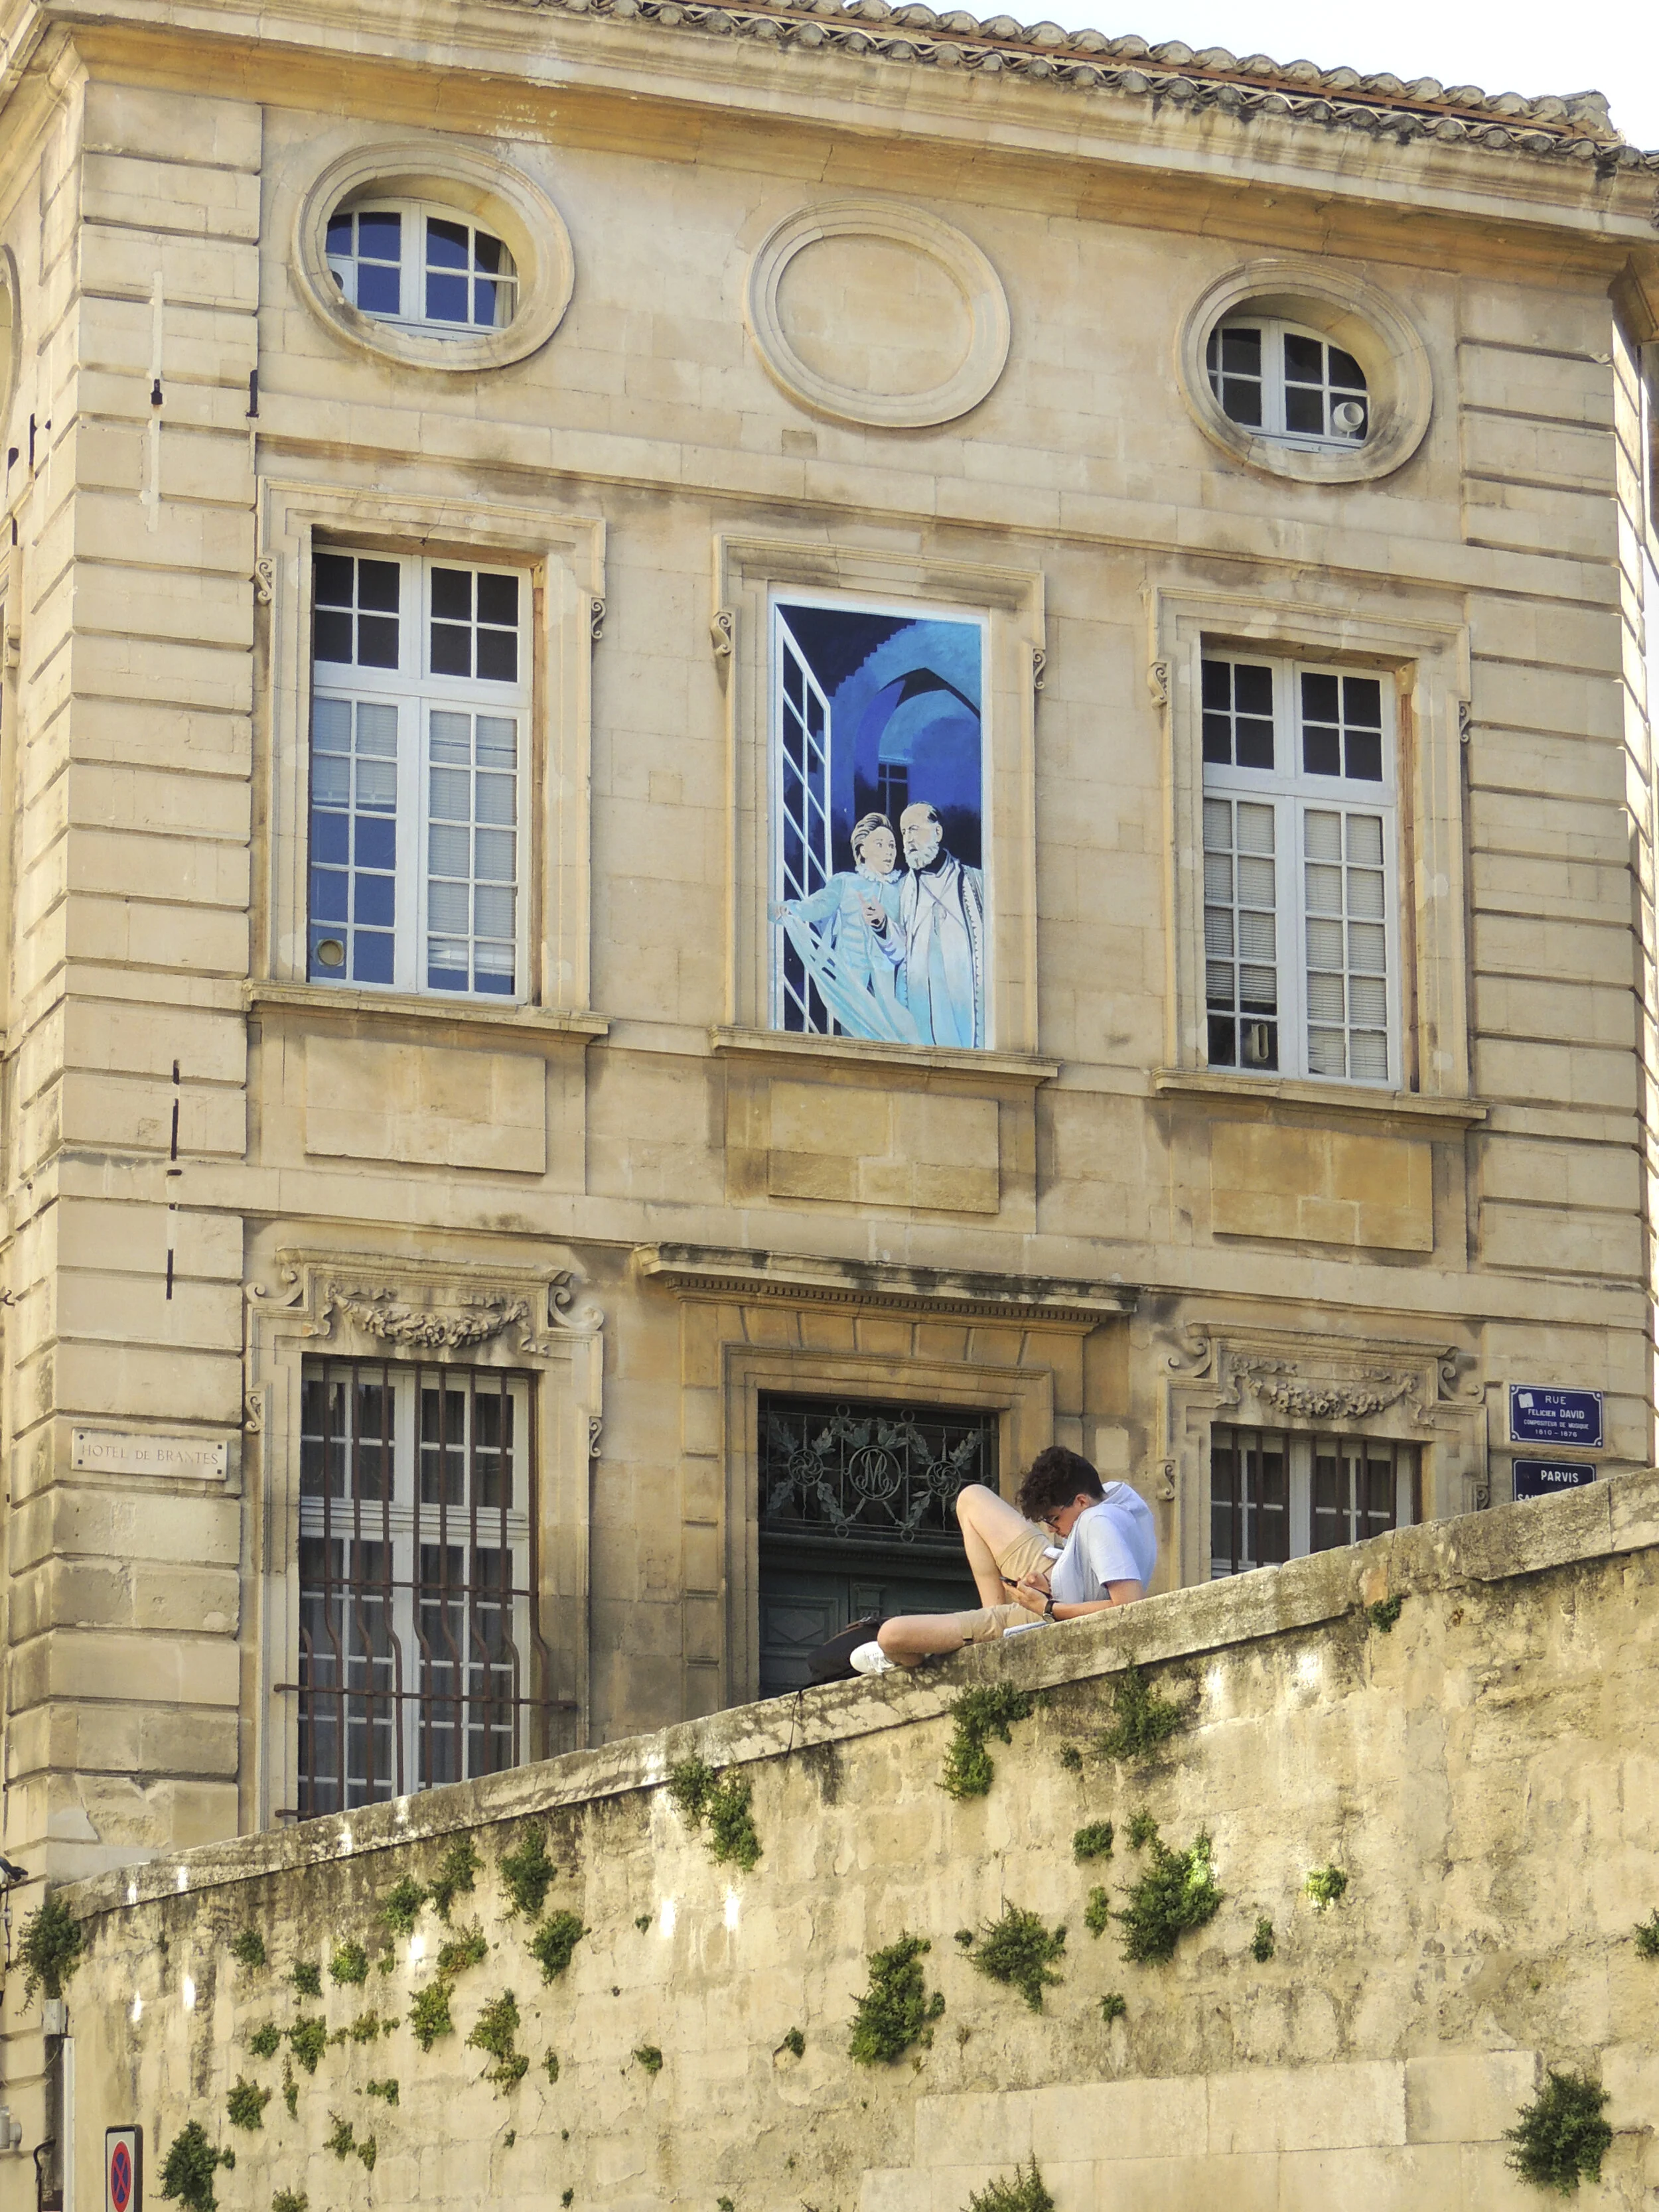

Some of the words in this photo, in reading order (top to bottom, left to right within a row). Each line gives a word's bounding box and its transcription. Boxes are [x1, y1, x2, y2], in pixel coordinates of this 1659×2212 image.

[1545, 1395, 1567, 1405] RUE
[1559, 1409, 1585, 1419] DAVID
[82, 1444, 127, 1458] HOTEL
[135, 1450, 150, 1460] DE
[157, 1449, 218, 1465] BRANTES
[1540, 1470, 1579, 1484] PARVIS
